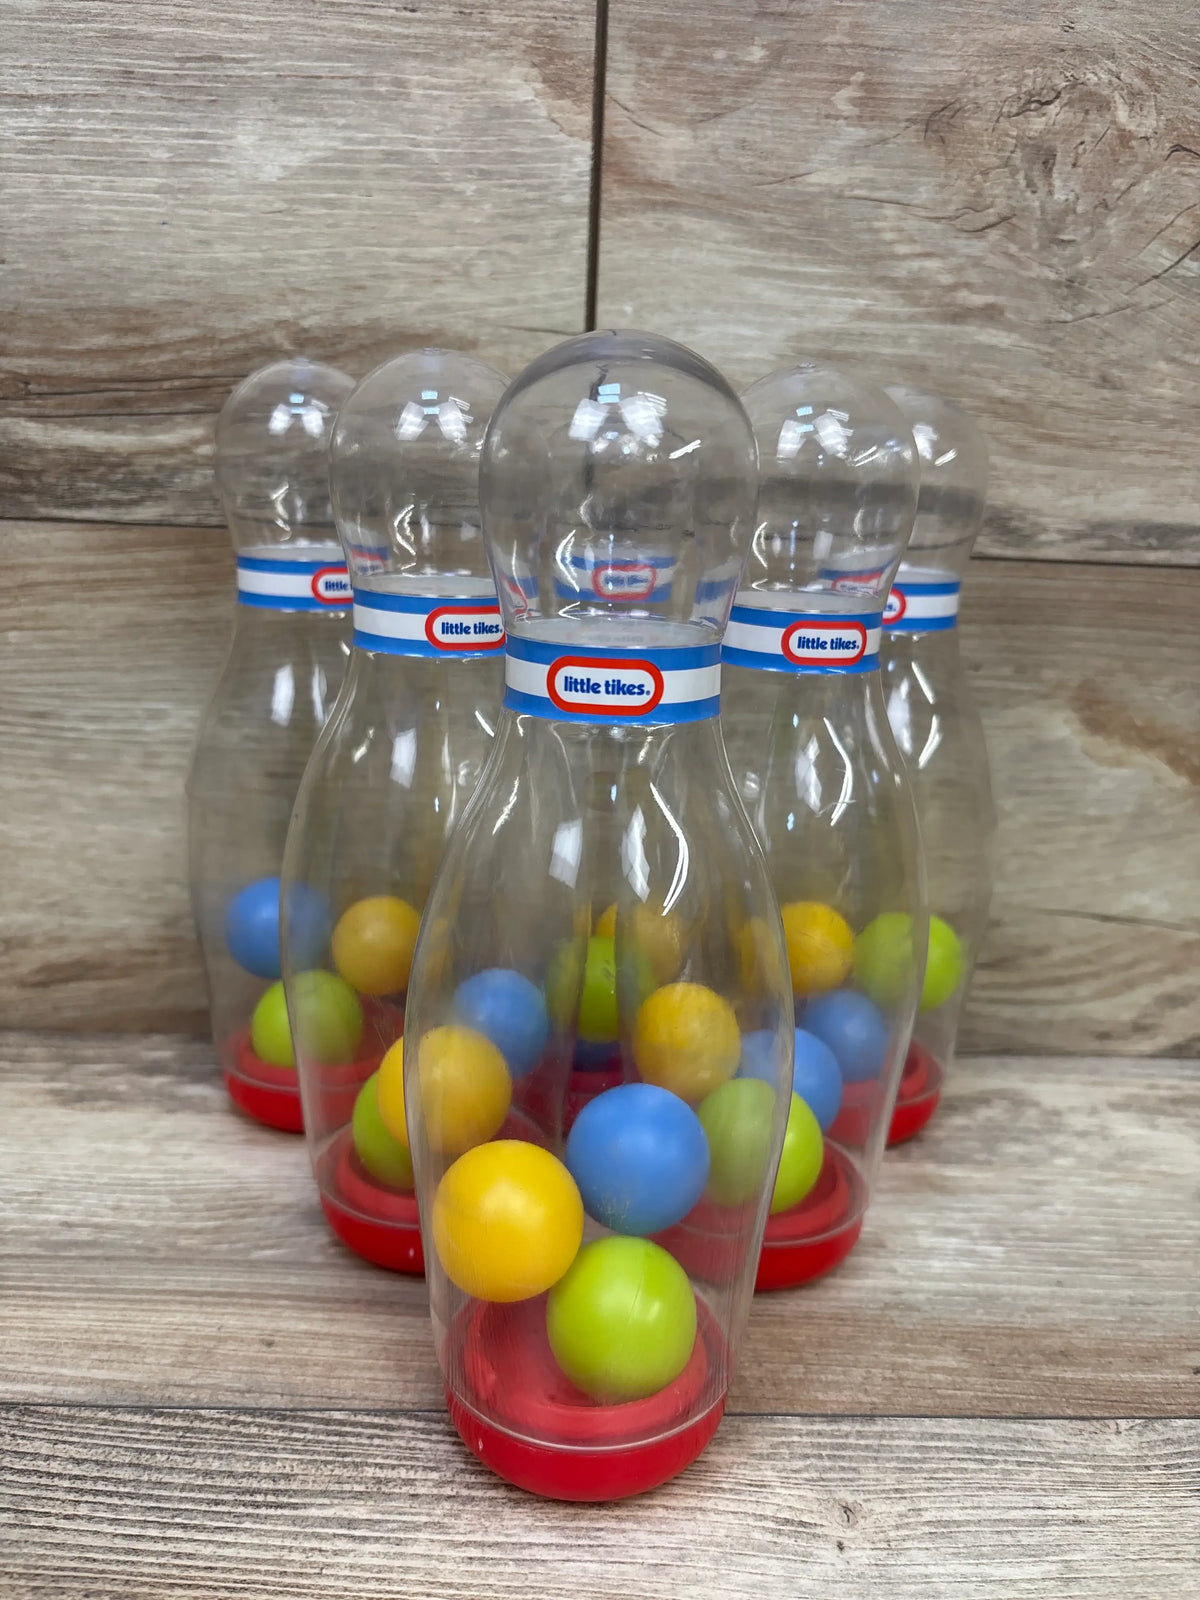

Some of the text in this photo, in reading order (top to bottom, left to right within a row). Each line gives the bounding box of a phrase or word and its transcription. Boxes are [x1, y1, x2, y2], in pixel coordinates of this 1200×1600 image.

[441, 621, 471, 635] little
[797, 636, 828, 650] little
[563, 675, 602, 695] little
